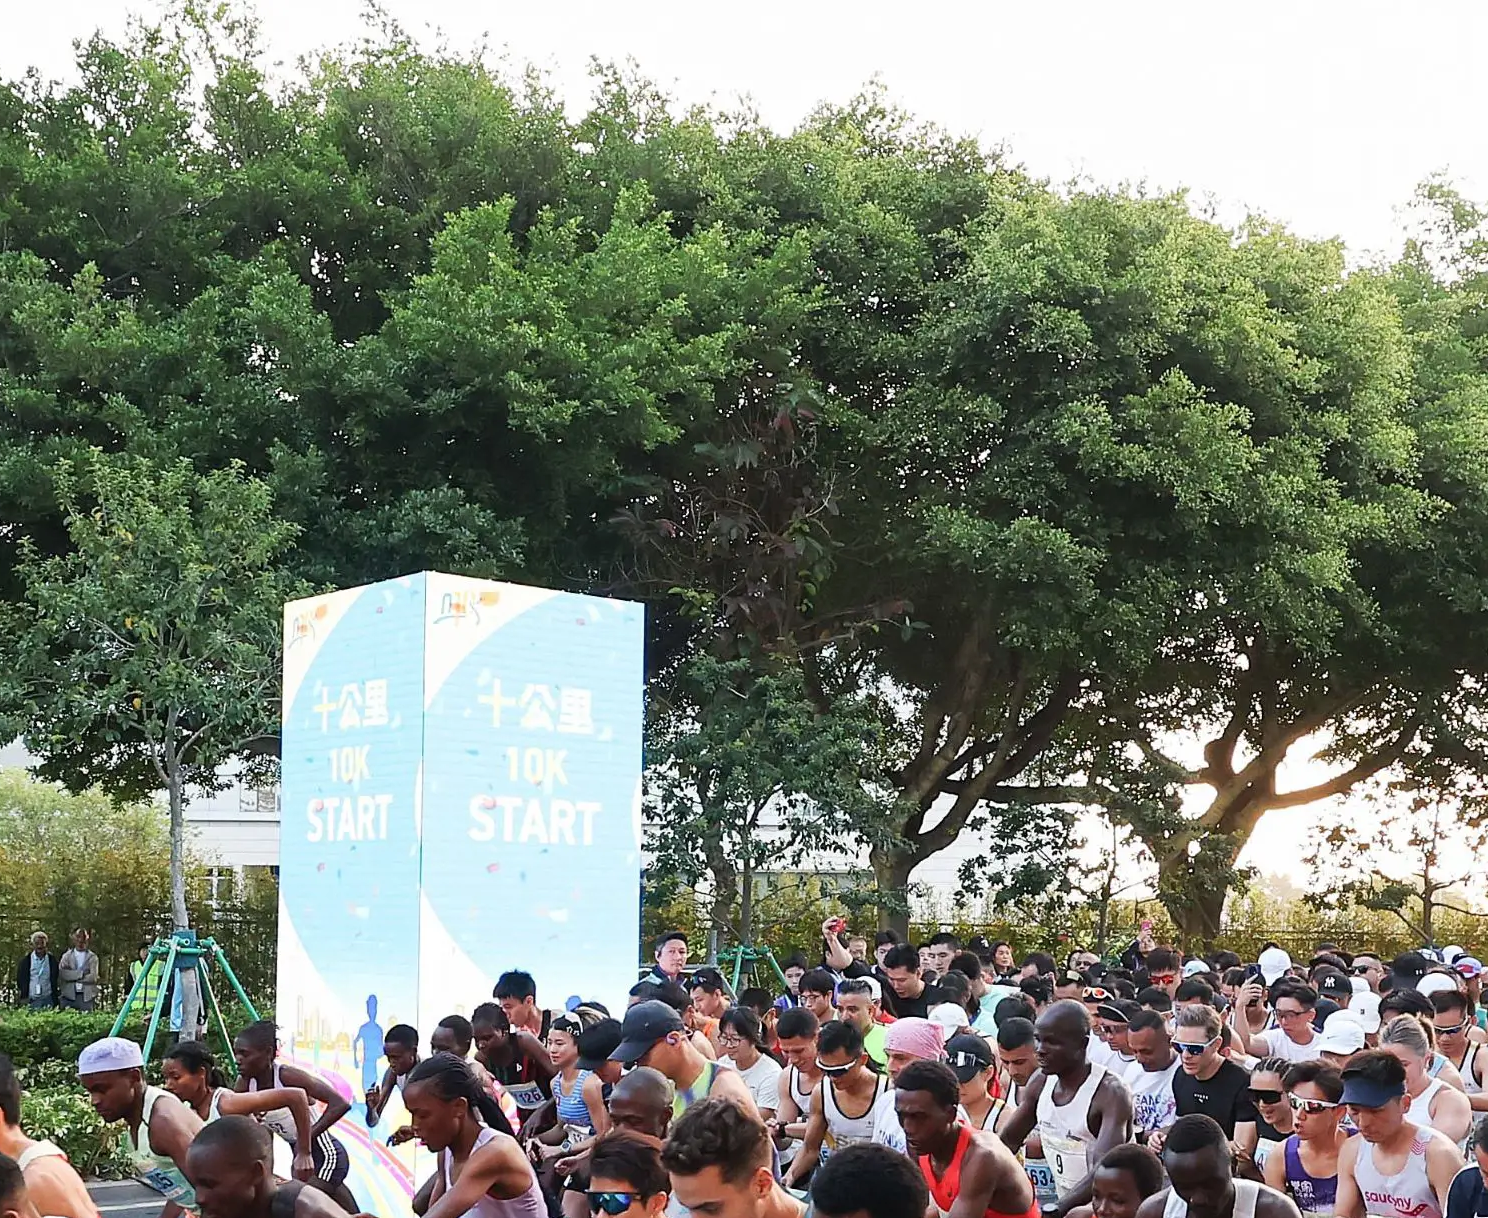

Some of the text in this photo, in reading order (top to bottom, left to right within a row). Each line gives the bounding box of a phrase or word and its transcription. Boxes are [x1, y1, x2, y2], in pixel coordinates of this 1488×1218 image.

[312, 677, 390, 735] 十公里
[477, 677, 595, 735] 十公里
[328, 743, 371, 785] 10K
[505, 745, 571, 786] 10K
[306, 793, 394, 843] START
[468, 796, 602, 846] START
[1055, 1154, 1064, 1175] 9
